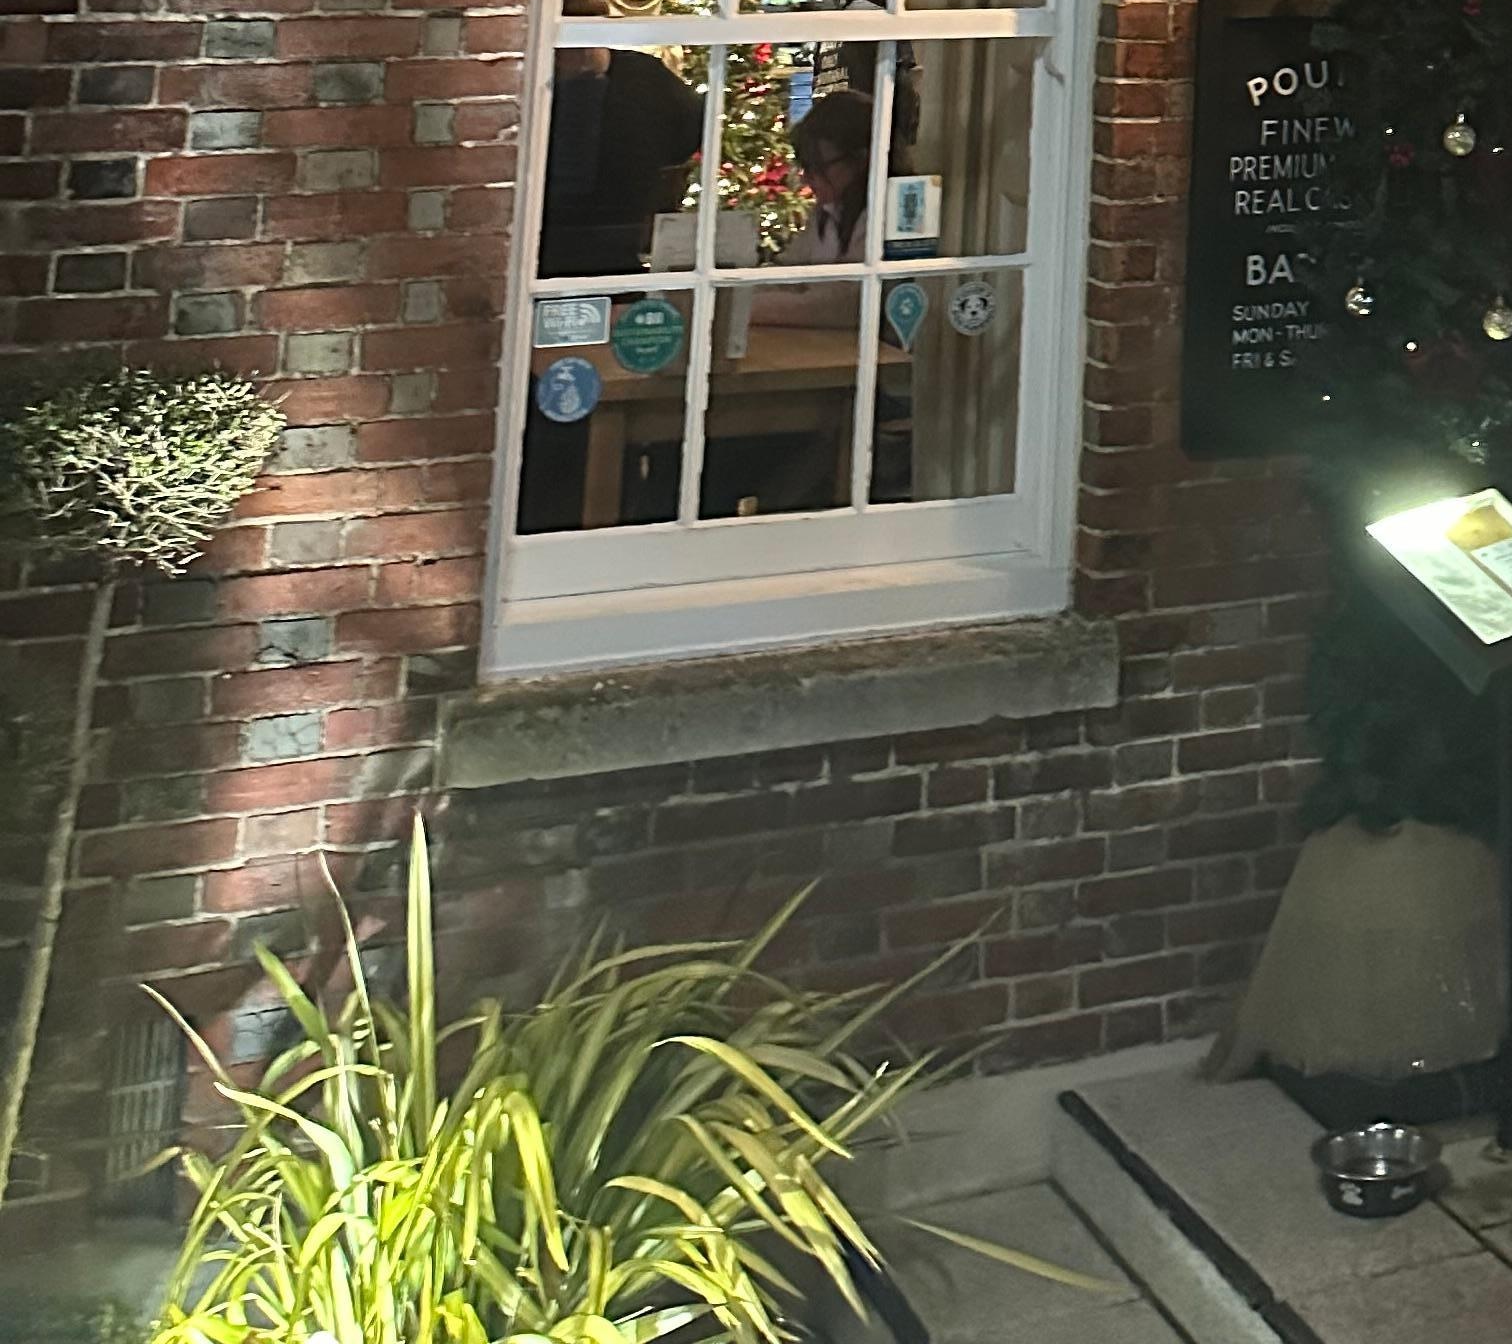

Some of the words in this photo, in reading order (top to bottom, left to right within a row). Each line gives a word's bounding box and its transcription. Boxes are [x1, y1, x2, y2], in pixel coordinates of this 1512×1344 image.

[1246, 60, 1344, 108] POU
[1234, 187, 1301, 216] REAL
[1232, 300, 1310, 323] SUNDAY
